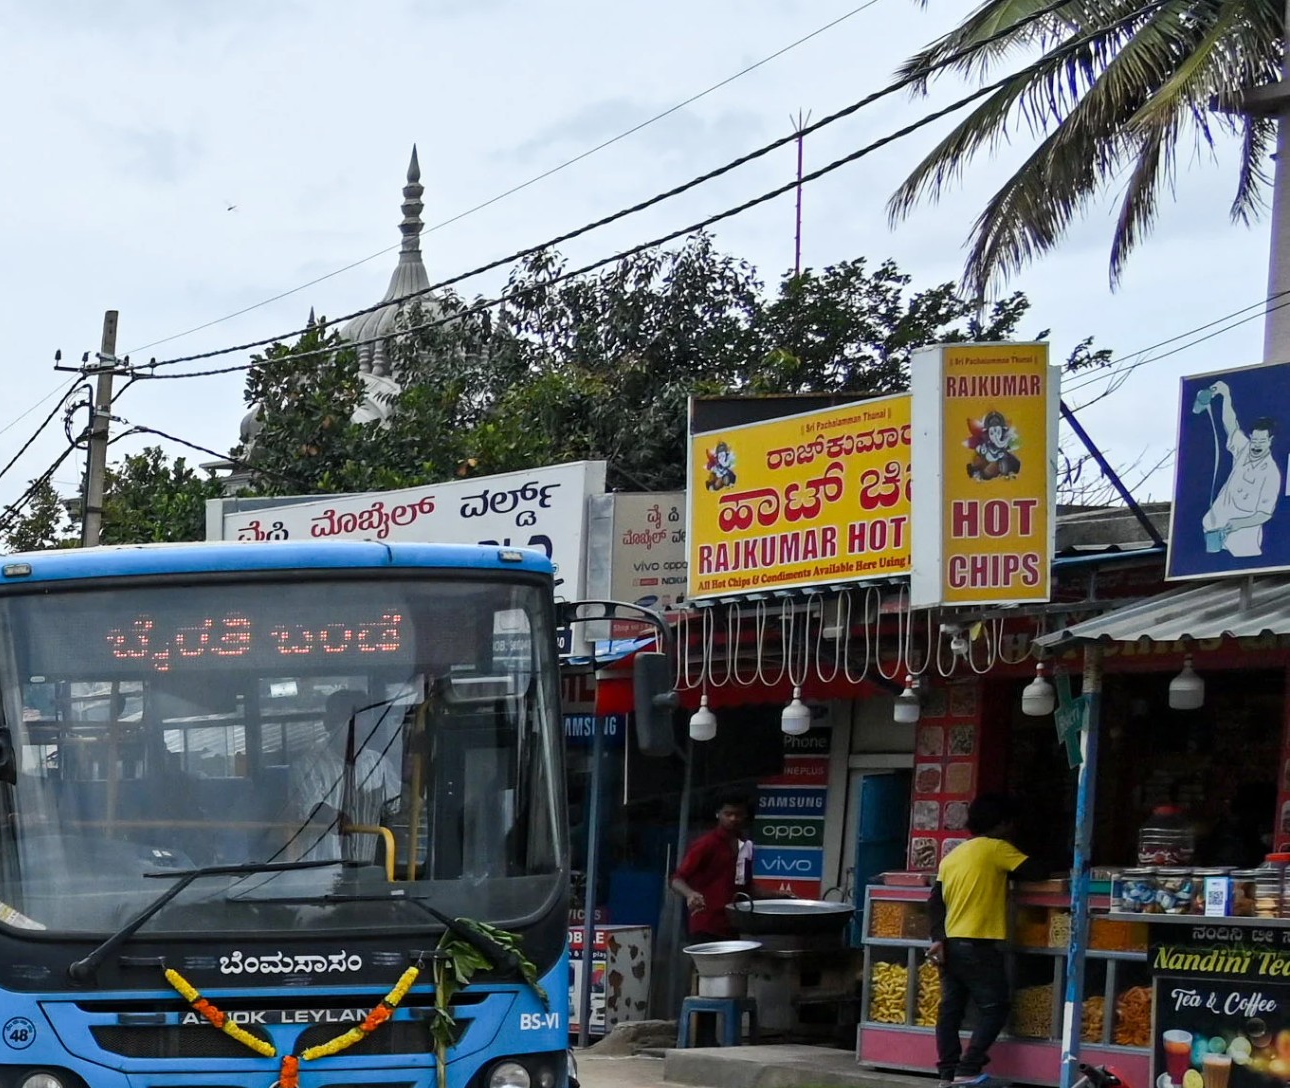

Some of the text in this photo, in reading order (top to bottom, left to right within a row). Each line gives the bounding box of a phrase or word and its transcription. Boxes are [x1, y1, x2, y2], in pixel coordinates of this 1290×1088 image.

[946, 374, 1040, 397] RAJKUMAR
[719, 461, 911, 533] ಹಾಟ್ ಚಿ
[311, 496, 435, 539] ಮೊಬೈಲ್
[952, 499, 1037, 538] HOT
[699, 517, 907, 575] RAJKUMAR HOT
[634, 561, 659, 571] vivo
[698, 579, 710, 591] All
[712, 576, 726, 590] Hot
[728, 573, 751, 589] Chips
[752, 572, 760, 585] &
[761, 567, 812, 584] Condiments
[813, 561, 854, 577] Available
[856, 557, 877, 571] Here
[879, 555, 906, 570] Using
[948, 553, 1040, 589] CHIPS
[784, 767, 824, 775] NEPLUS
[759, 797, 823, 808] SAMSUNG
[762, 825, 816, 839] oppo
[761, 856, 811, 871] vivo
[1193, 926, 1243, 941] ನಂದಿನಿ
[220, 950, 362, 974] ಬೆಂಮಸಾಸಂ
[1154, 947, 1252, 974] Nandini
[1171, 988, 1277, 1017] Tea & Coffee
[183, 1008, 387, 1025] AOK LEYLAN
[520, 1012, 559, 1030] BS-VI
[10, 1029, 28, 1042] 48
